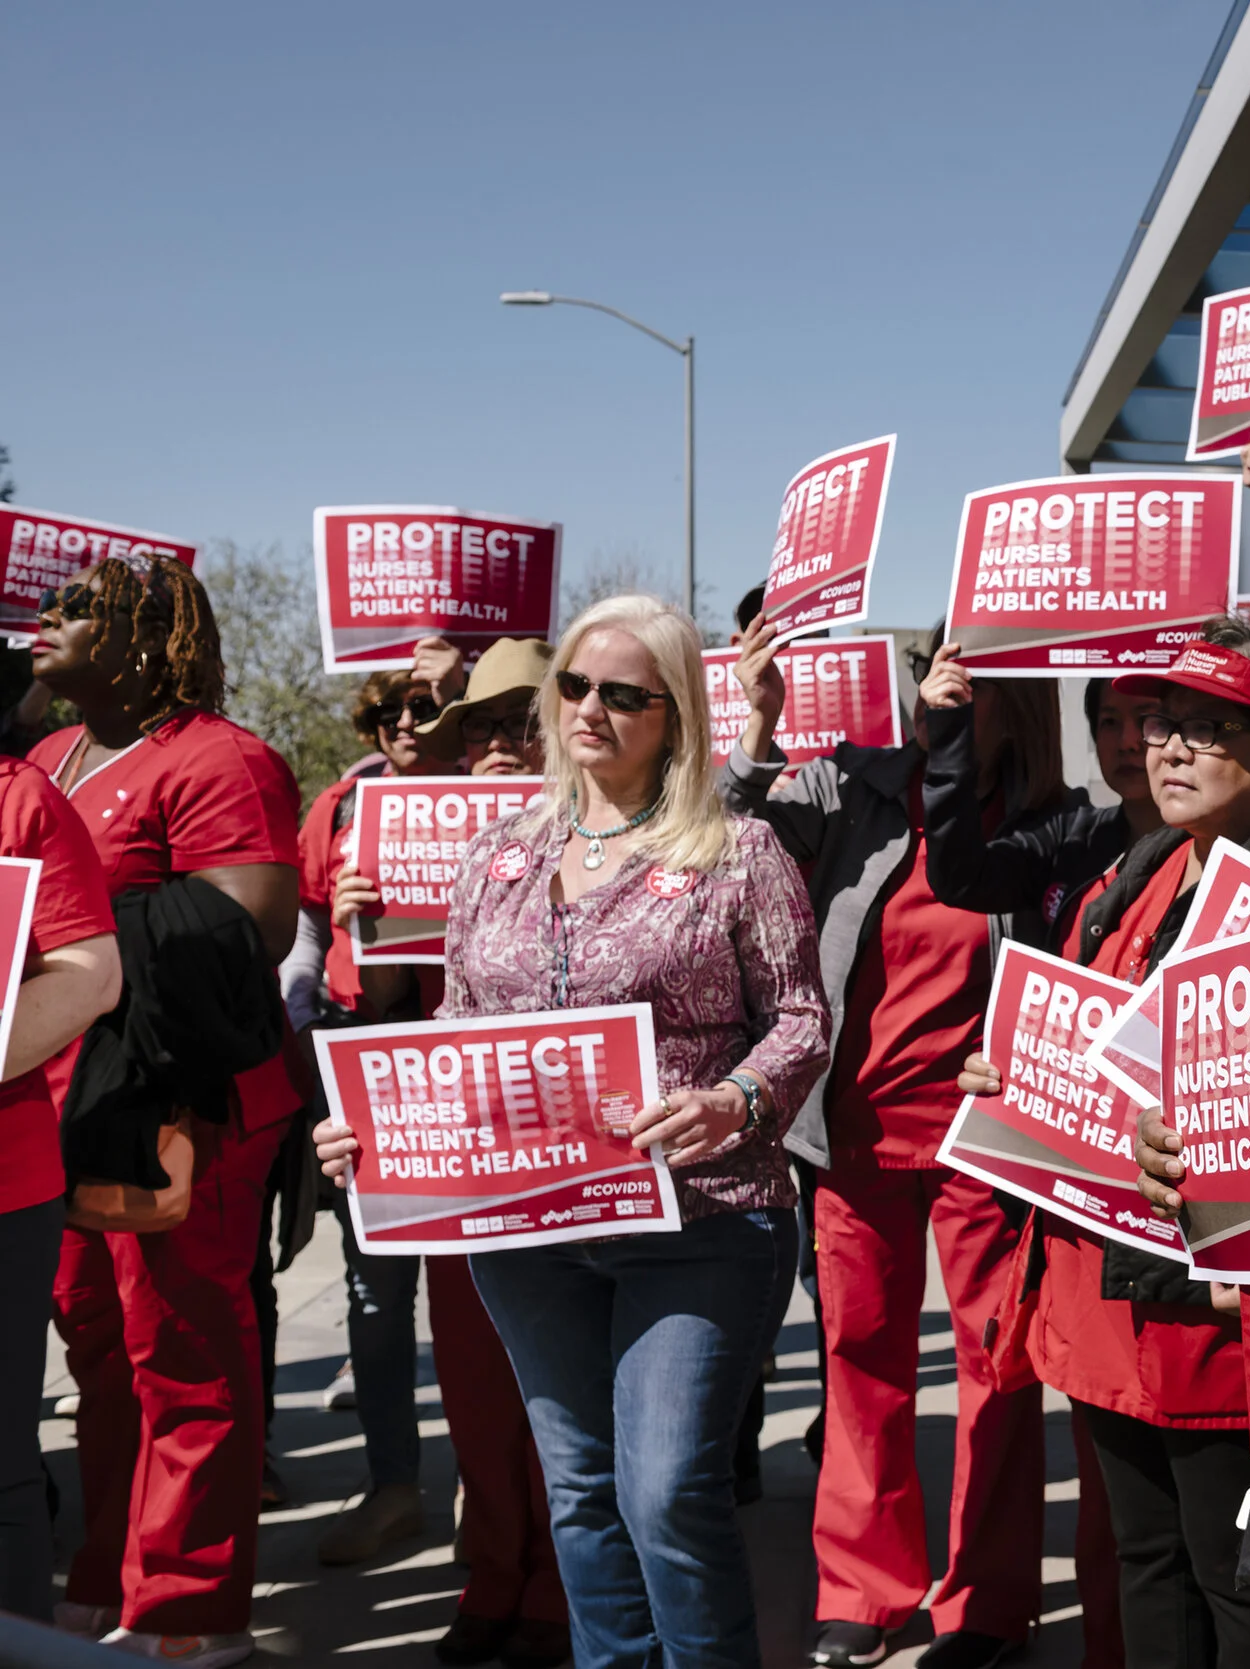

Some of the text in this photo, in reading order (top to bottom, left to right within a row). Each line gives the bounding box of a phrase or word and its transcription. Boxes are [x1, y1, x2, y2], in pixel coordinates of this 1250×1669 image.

[781, 457, 869, 525] OTECT
[983, 491, 1205, 537] PROTECT
[347, 521, 535, 561] PROTECT
[979, 543, 1071, 568] NURSES
[348, 560, 433, 579] NURSES
[776, 552, 832, 589] HEALTH
[975, 567, 1092, 590] PATIENTS
[349, 578, 452, 598] PATIENTS
[972, 590, 1167, 613] PUBLIC HEALTH
[350, 597, 508, 622] PUBLIC HEALTH
[706, 651, 867, 694] PRTECT
[1190, 649, 1228, 665] National
[379, 793, 549, 829] PROTE
[378, 841, 468, 860] NURSES
[1019, 971, 1125, 1041] PRO
[359, 1032, 604, 1089] PROTECT
[1012, 1029, 1099, 1083] NURSES
[1009, 1056, 1114, 1119] PATIENTS
[370, 1102, 467, 1128] NURSES
[1003, 1084, 1137, 1161] PUBLIC HEA
[375, 1127, 496, 1154] PATIENTS
[379, 1142, 588, 1180] PUBLIC HEALTH
[582, 1181, 652, 1198] #COVID19
